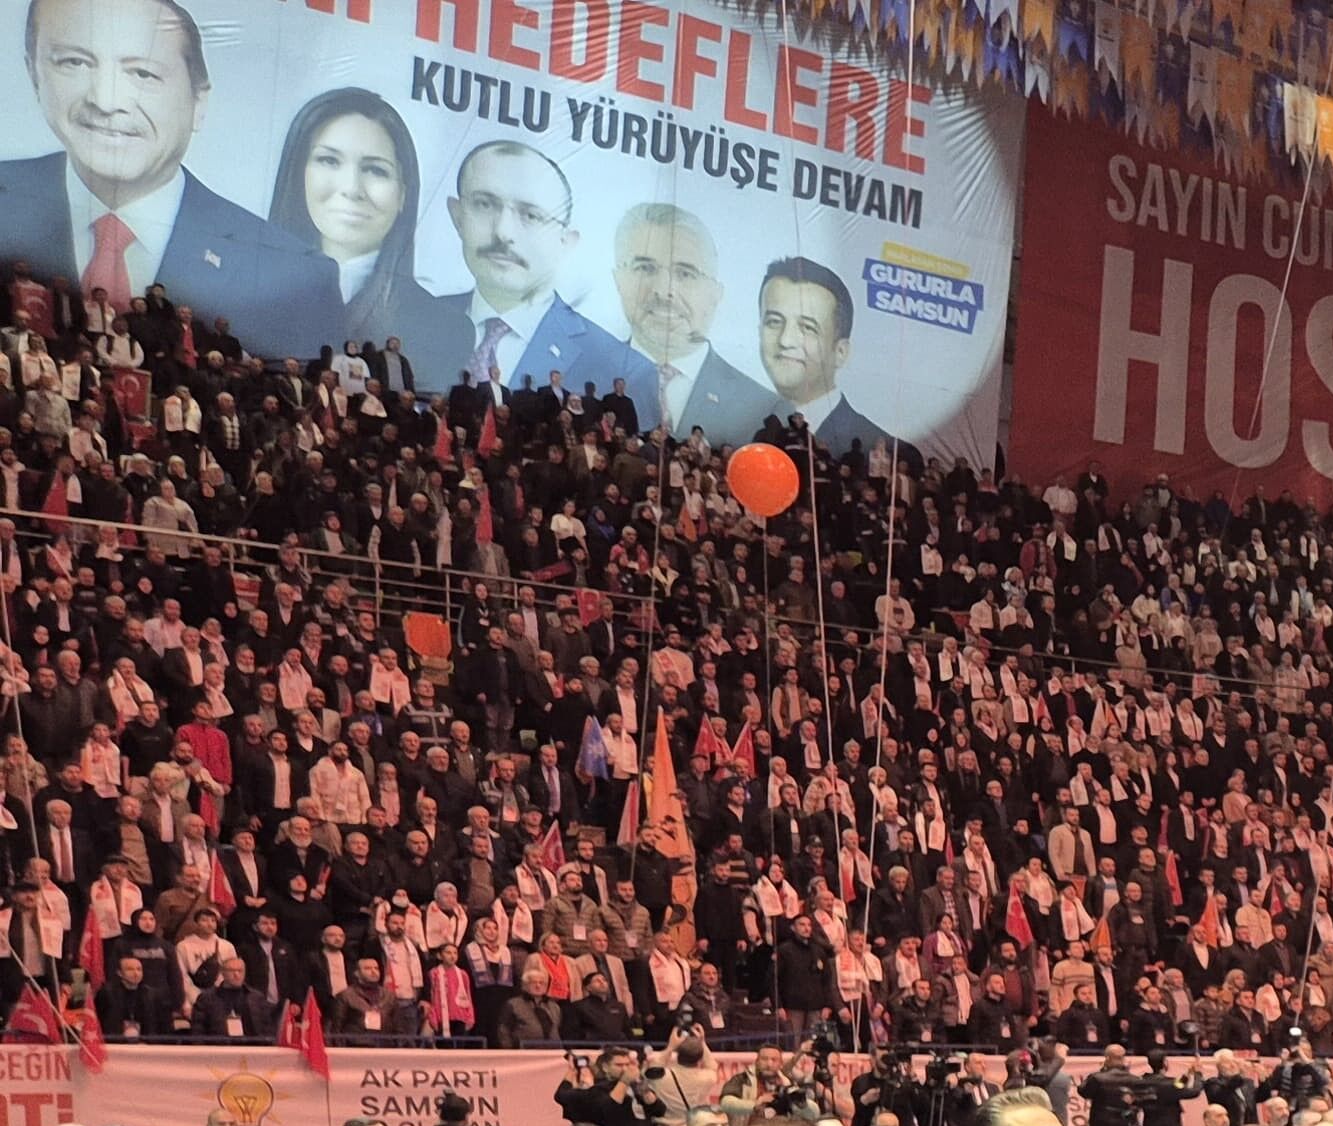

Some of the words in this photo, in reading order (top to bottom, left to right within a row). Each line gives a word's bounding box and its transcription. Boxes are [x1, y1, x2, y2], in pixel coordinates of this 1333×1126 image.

[416, 0, 933, 175] HEDEFLERE
[411, 56, 552, 134] KUTLU
[567, 97, 780, 192] YÜRÜYÜŞE
[793, 157, 924, 230] DEVAM
[1106, 153, 1247, 251] SAYIN
[869, 262, 977, 306] GURURLA
[875, 290, 971, 330] SAMSUN
[360, 1069, 402, 1089] AK
